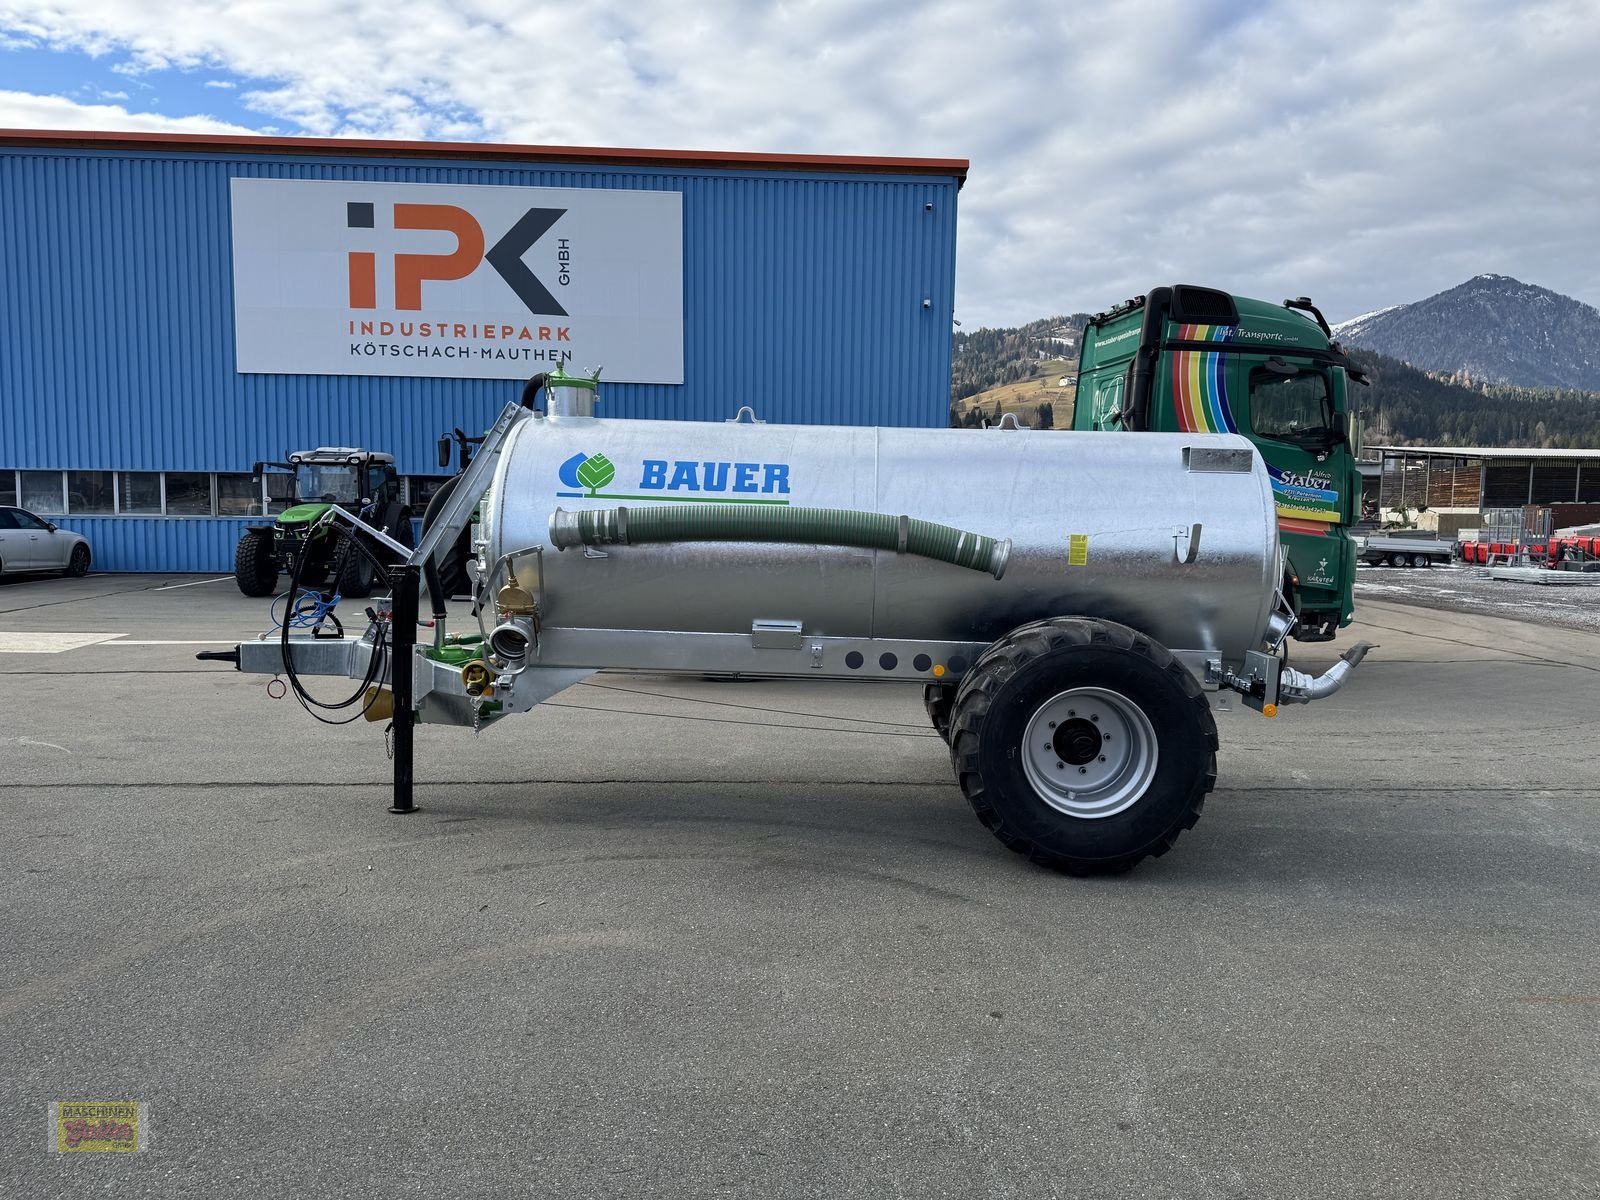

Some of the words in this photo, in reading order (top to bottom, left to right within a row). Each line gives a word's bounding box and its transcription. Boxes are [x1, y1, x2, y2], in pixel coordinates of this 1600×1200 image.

[558, 238, 570, 286] GMBH
[349, 321, 571, 342] INDUSTRIEPARK
[1238, 328, 1283, 341] Transporte
[350, 342, 572, 362] KÖTSCHACH-MAUTHEN
[639, 459, 790, 494] BAUER
[1279, 469, 1330, 489] Staber
